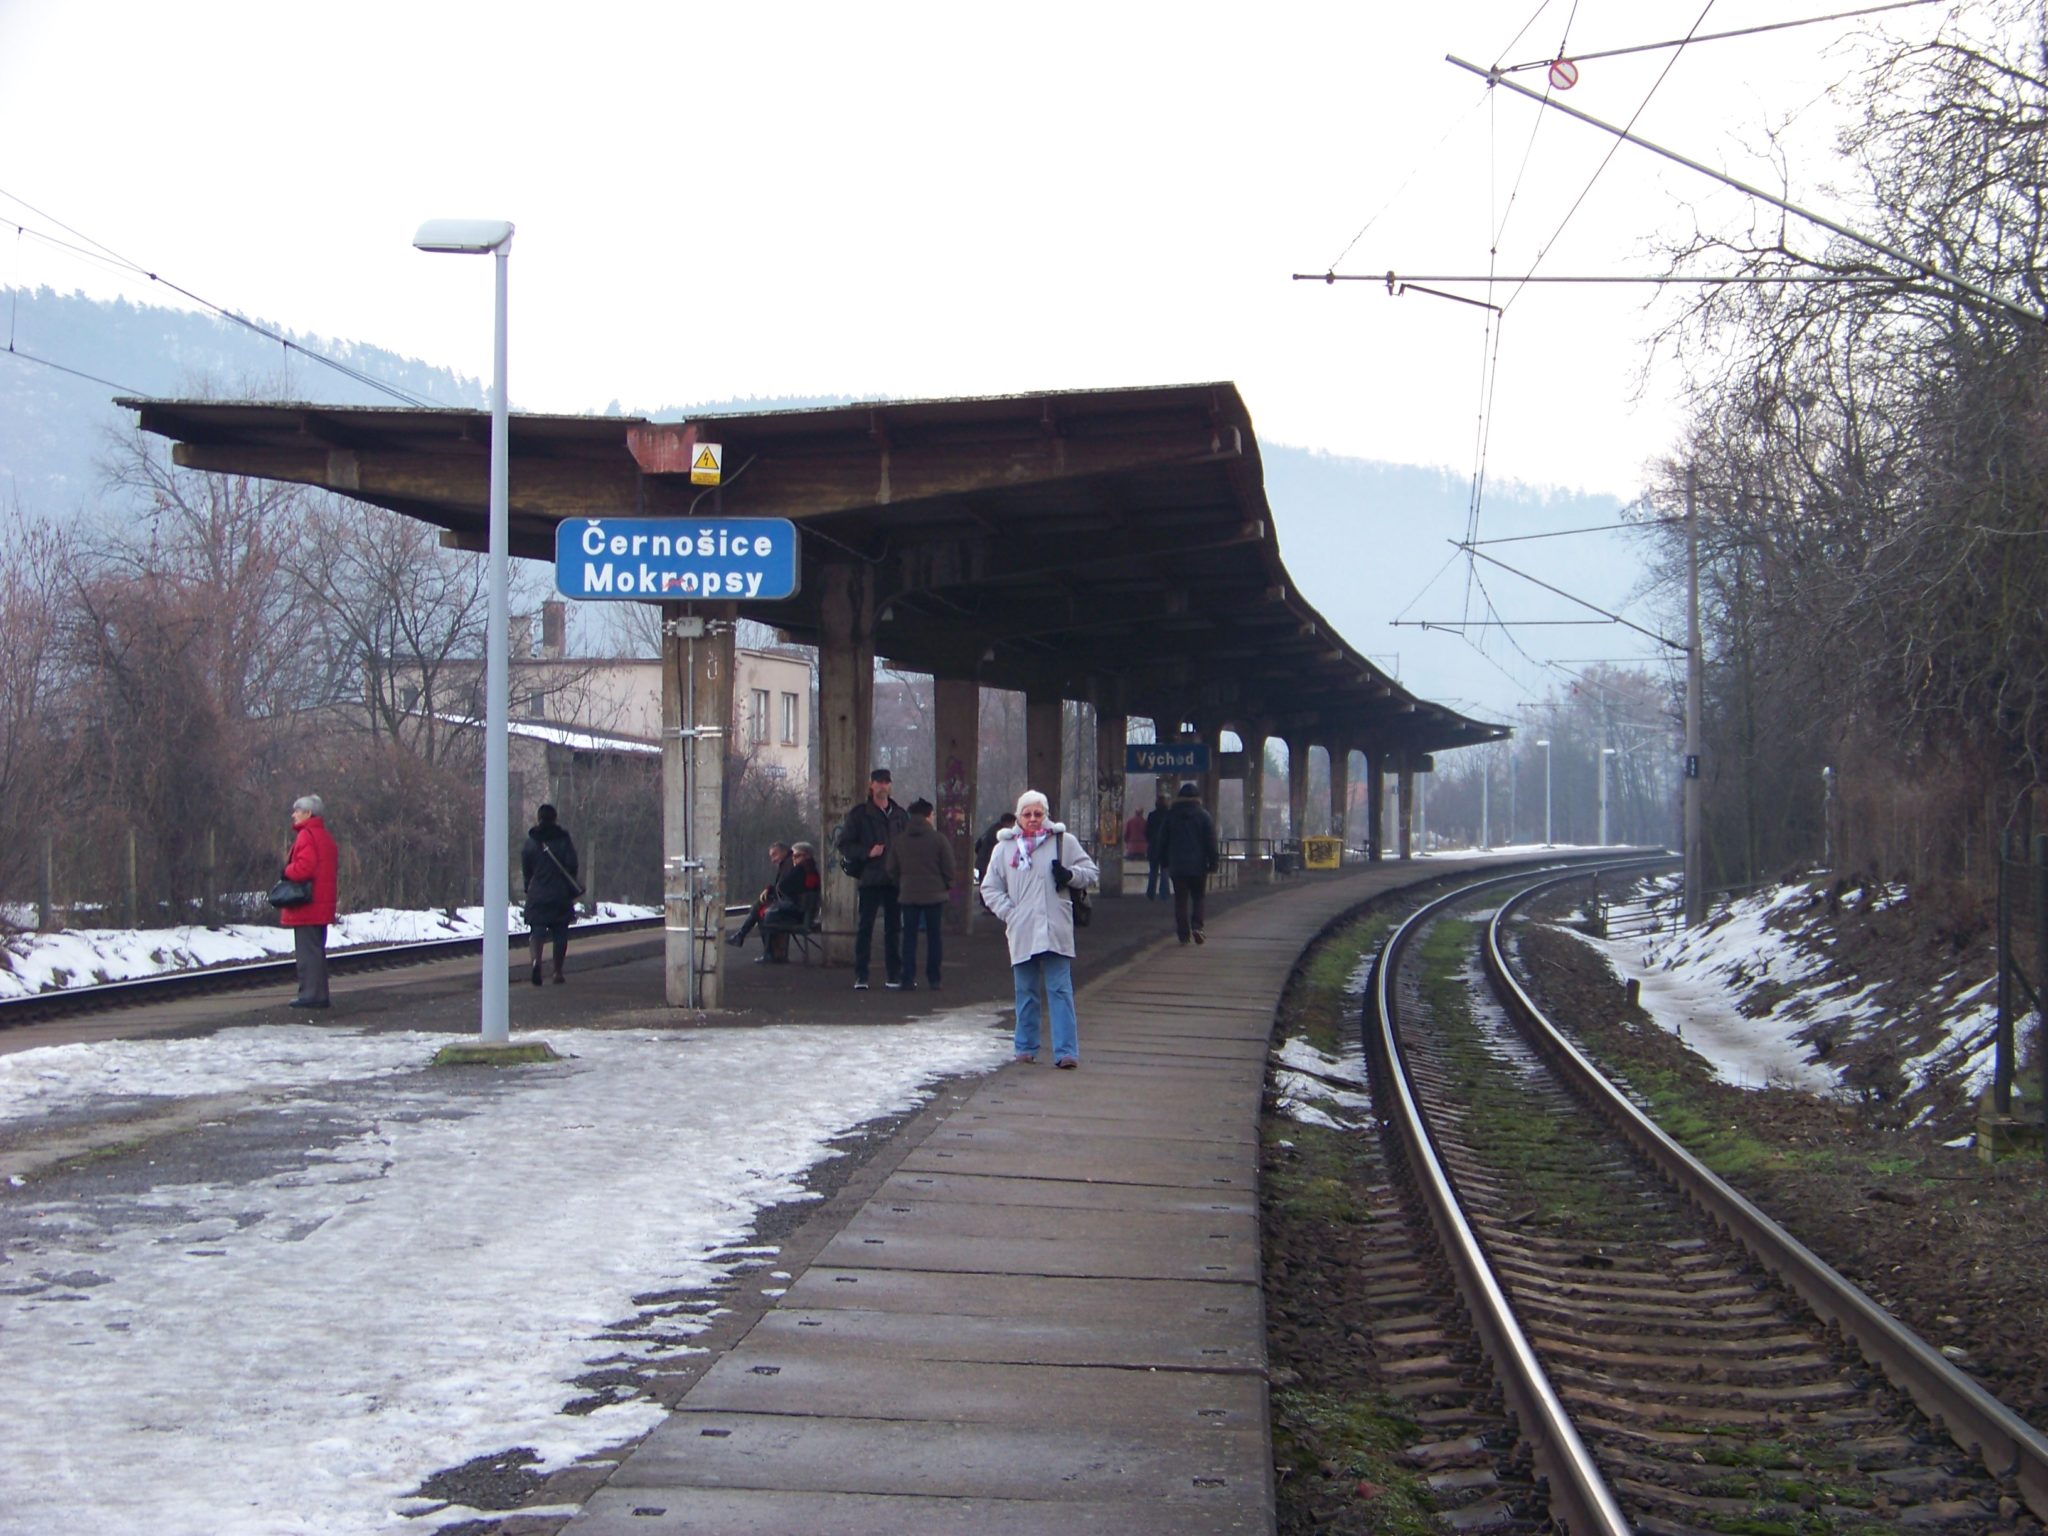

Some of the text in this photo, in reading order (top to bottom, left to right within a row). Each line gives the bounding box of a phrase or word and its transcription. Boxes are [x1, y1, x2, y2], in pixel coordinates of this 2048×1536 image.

[582, 519, 772, 556] Černošice
[584, 562, 764, 598] Mokropsy
[1136, 750, 1195, 769] Východ
